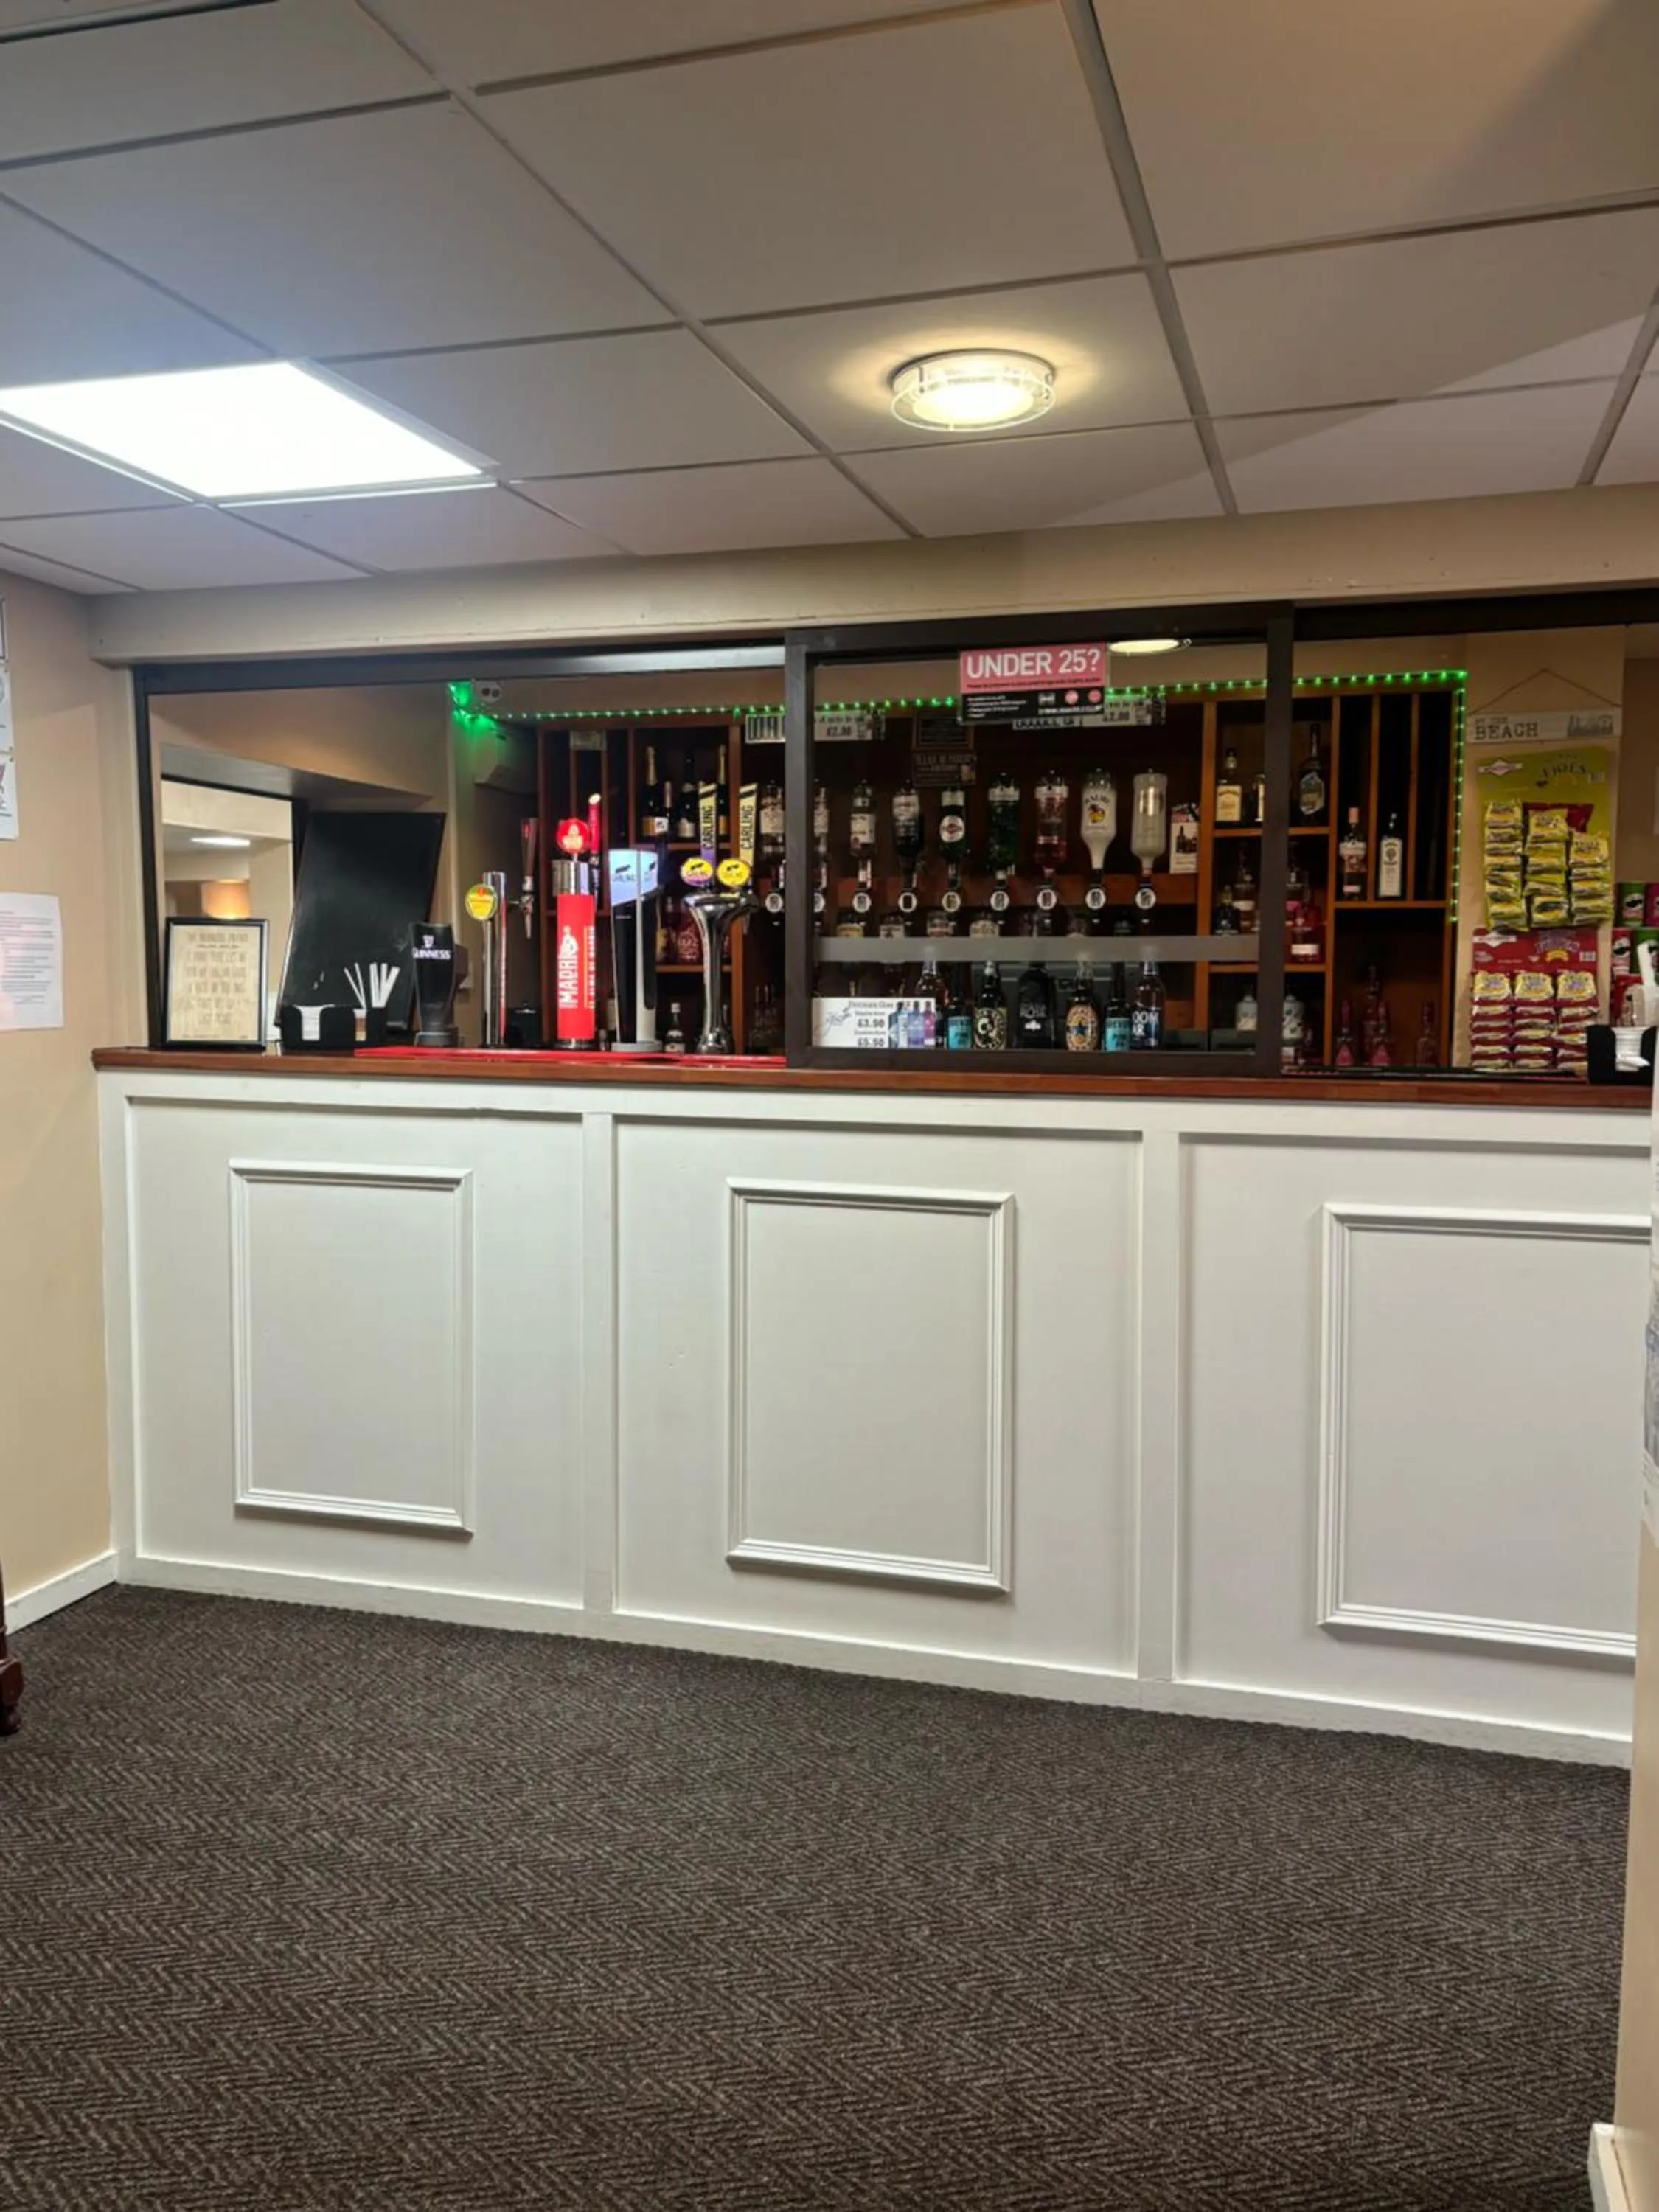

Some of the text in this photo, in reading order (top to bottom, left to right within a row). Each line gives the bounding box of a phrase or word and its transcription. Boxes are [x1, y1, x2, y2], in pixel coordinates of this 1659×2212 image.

[967, 647, 1101, 678] UNDER 25?
[1475, 723, 1538, 740] BEACH
[701, 804, 714, 850] CARLING
[742, 804, 755, 850] CARLING
[412, 947, 451, 960] GUINNESS
[1132, 1010, 1159, 1023] OOM
